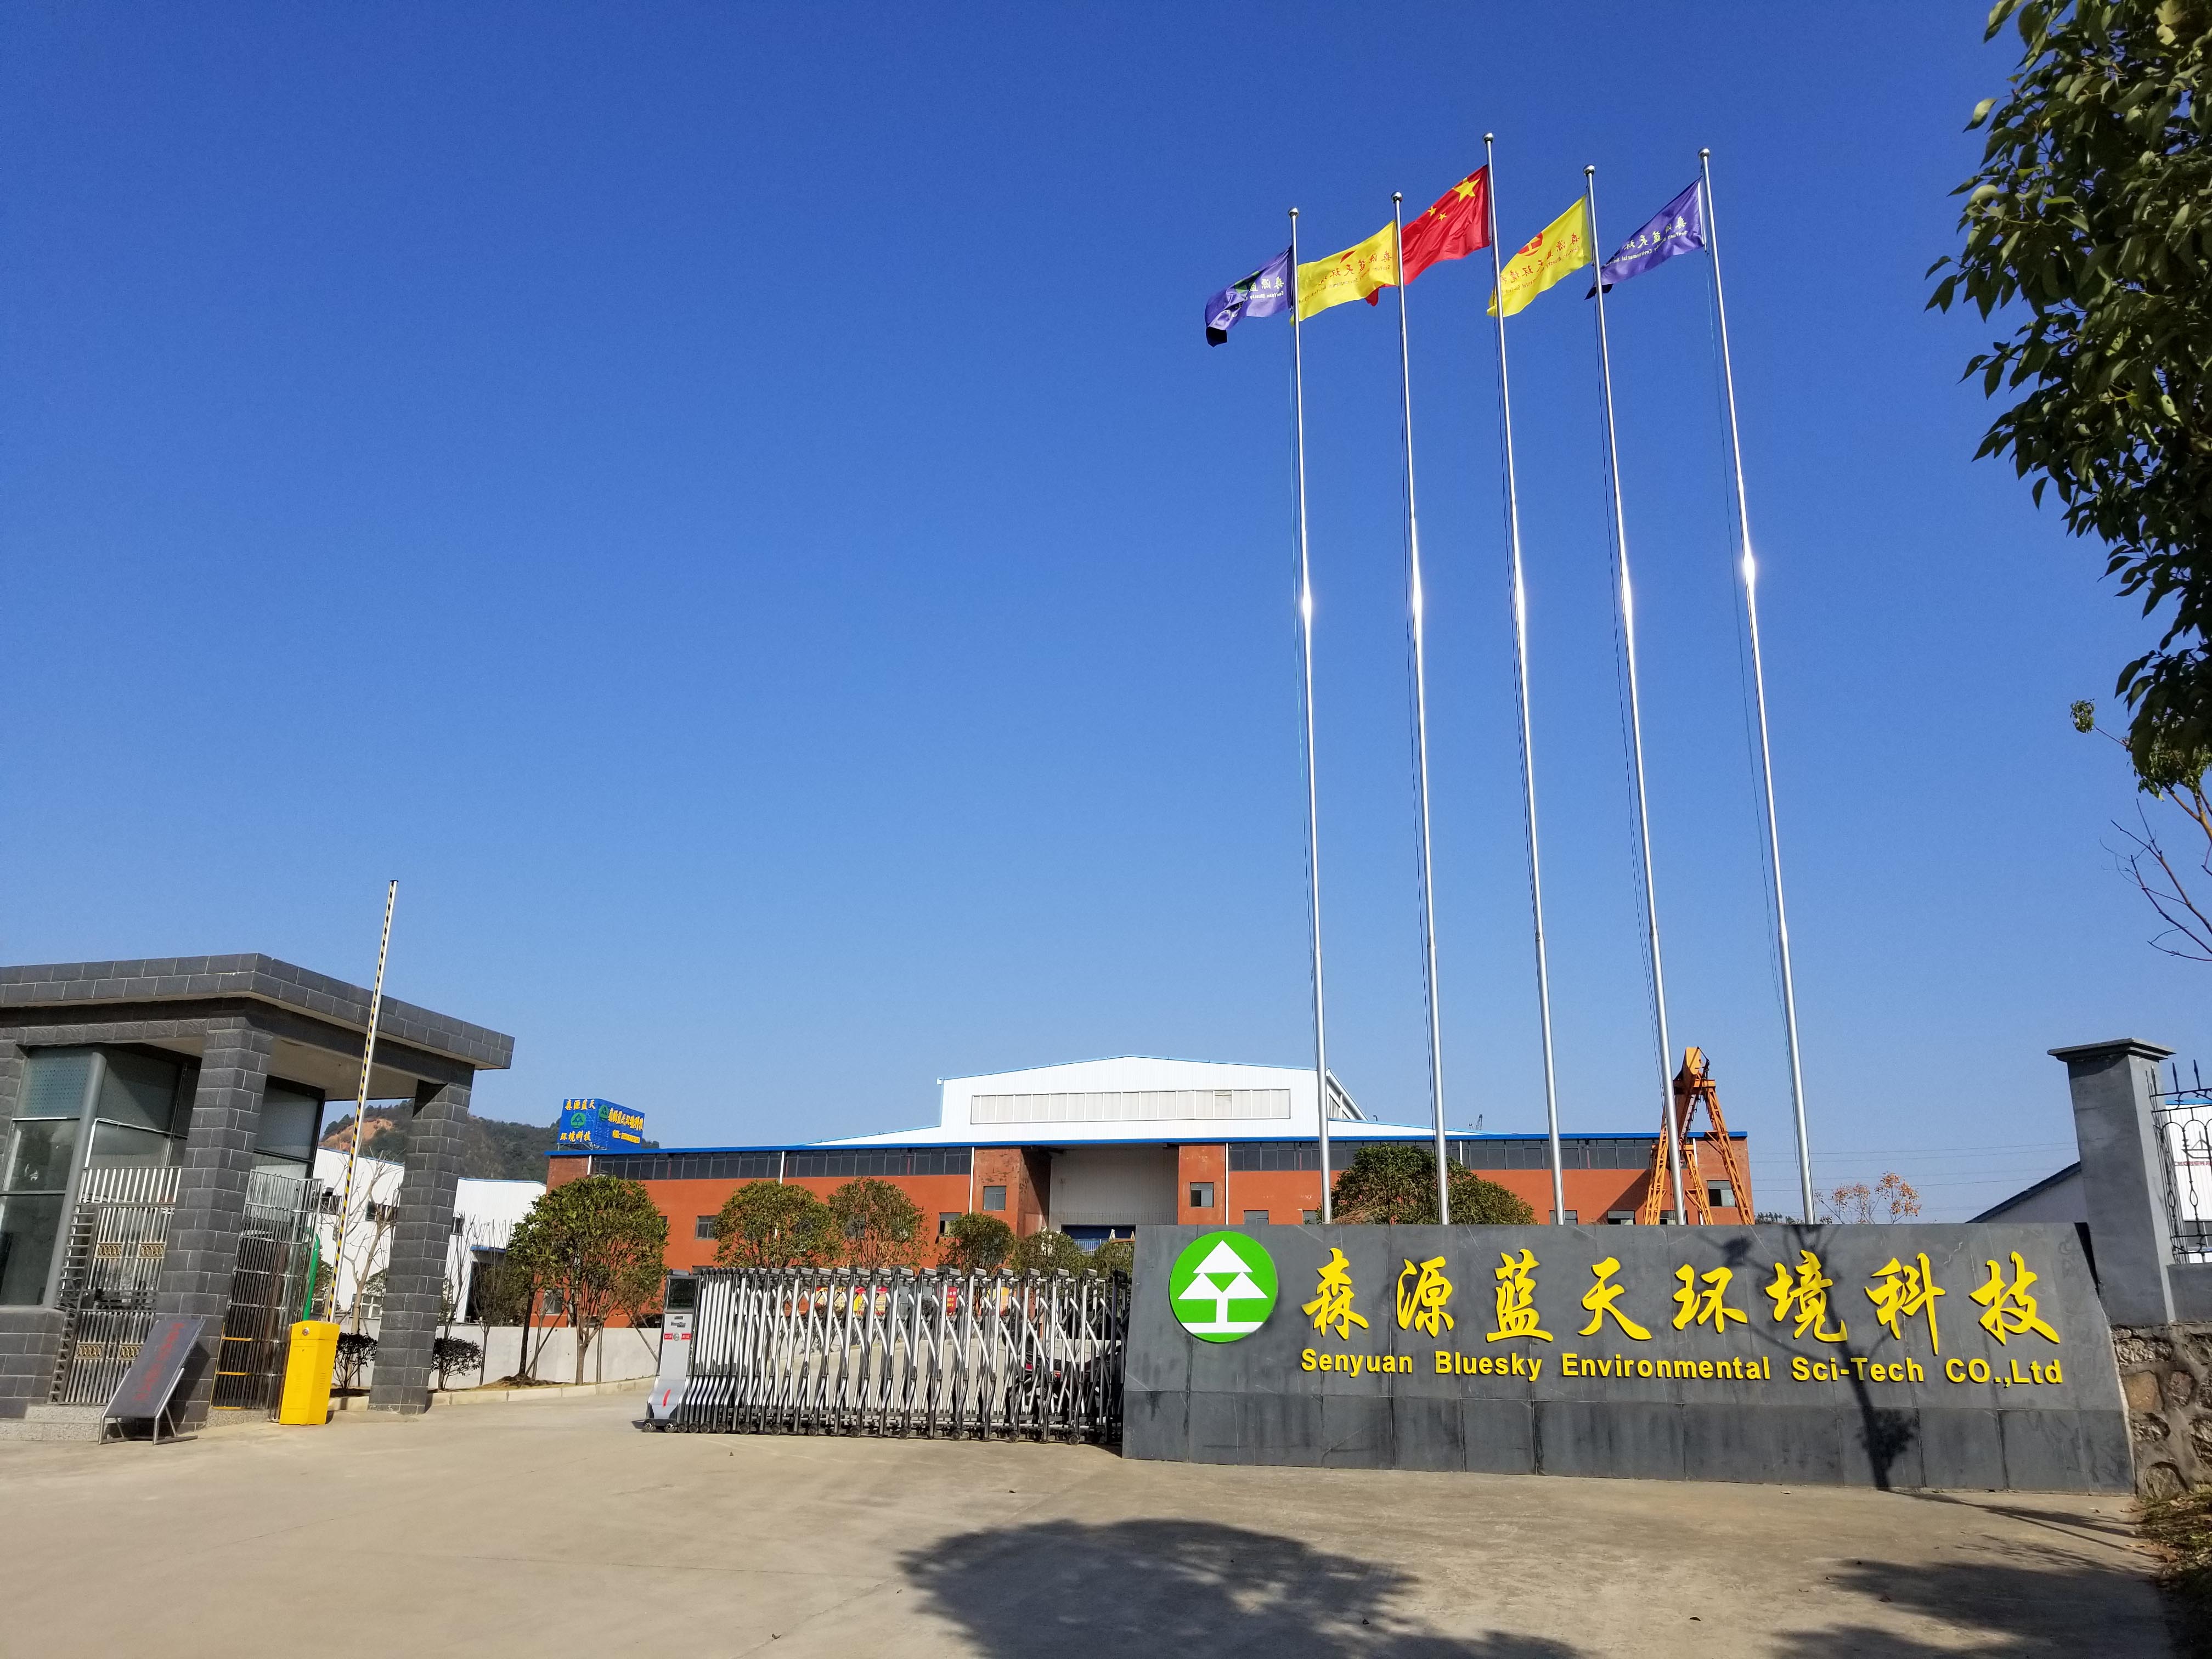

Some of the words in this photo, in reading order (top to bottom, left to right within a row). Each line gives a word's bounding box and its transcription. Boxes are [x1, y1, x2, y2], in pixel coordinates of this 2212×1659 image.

[1302, 1248, 2061, 1353] 森源蓝天环境科技
[1301, 1348, 1413, 1378] Senyuan
[1435, 1351, 1543, 1382] Bluesky
[1562, 1353, 1770, 1380] Environmental
[1792, 1357, 1925, 1382] Sci-Tech
[1945, 1359, 2063, 1387] CO.,Ltd
